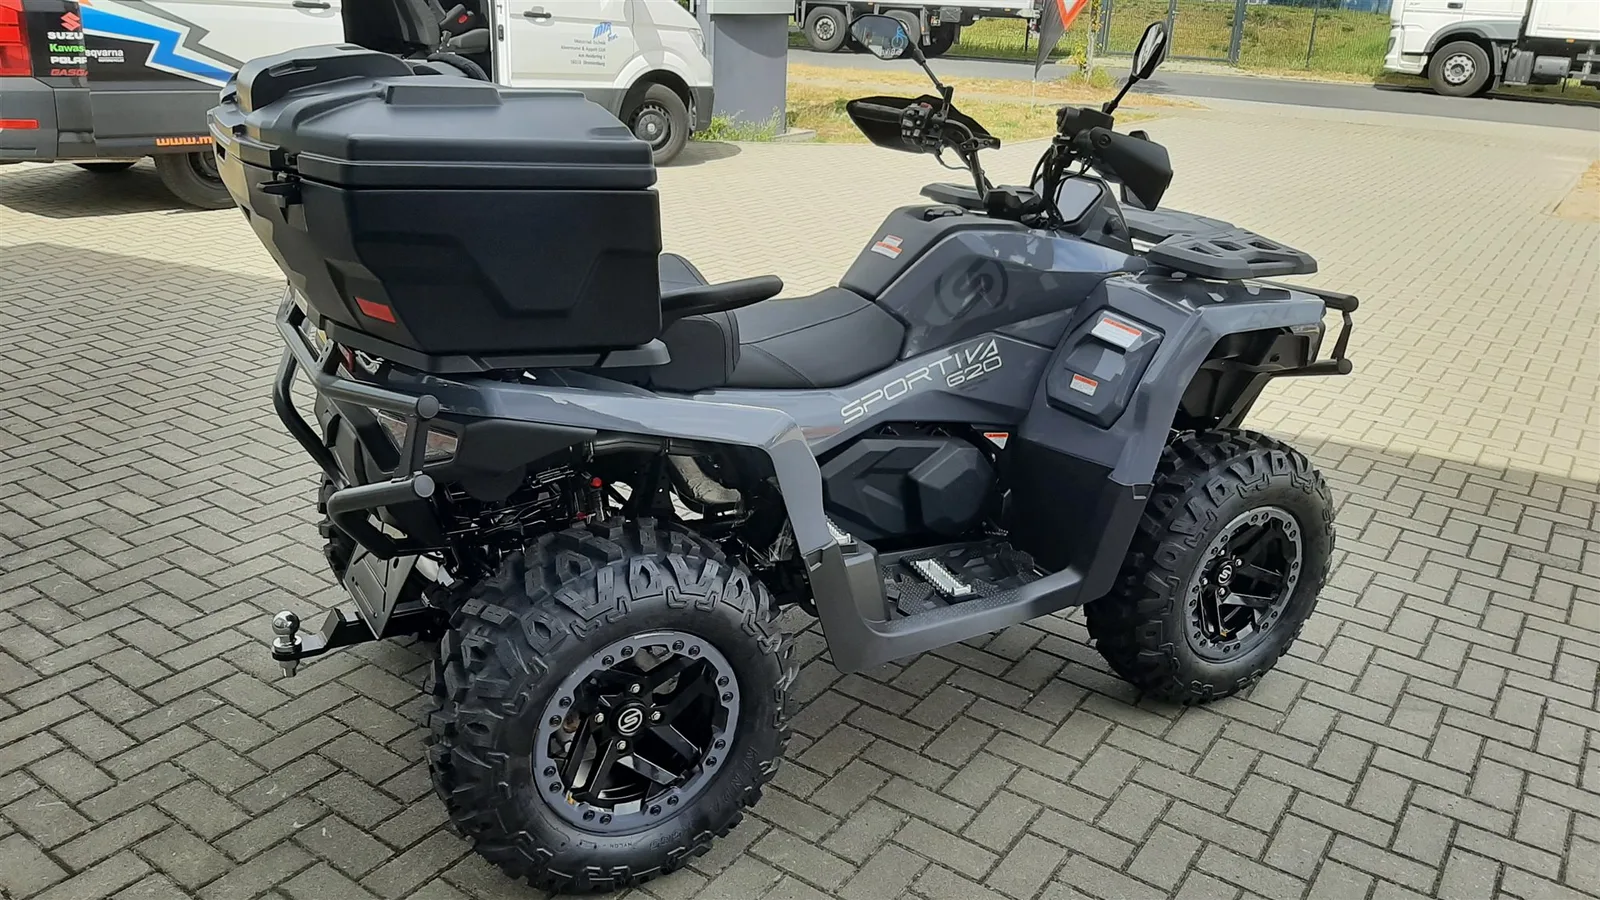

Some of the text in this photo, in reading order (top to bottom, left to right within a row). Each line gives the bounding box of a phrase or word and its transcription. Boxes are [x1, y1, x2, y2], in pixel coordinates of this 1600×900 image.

[47, 31, 83, 40] SUZU
[49, 43, 85, 52] Kawas
[841, 338, 999, 425] SPORTIVA
[946, 355, 1003, 388] 620
